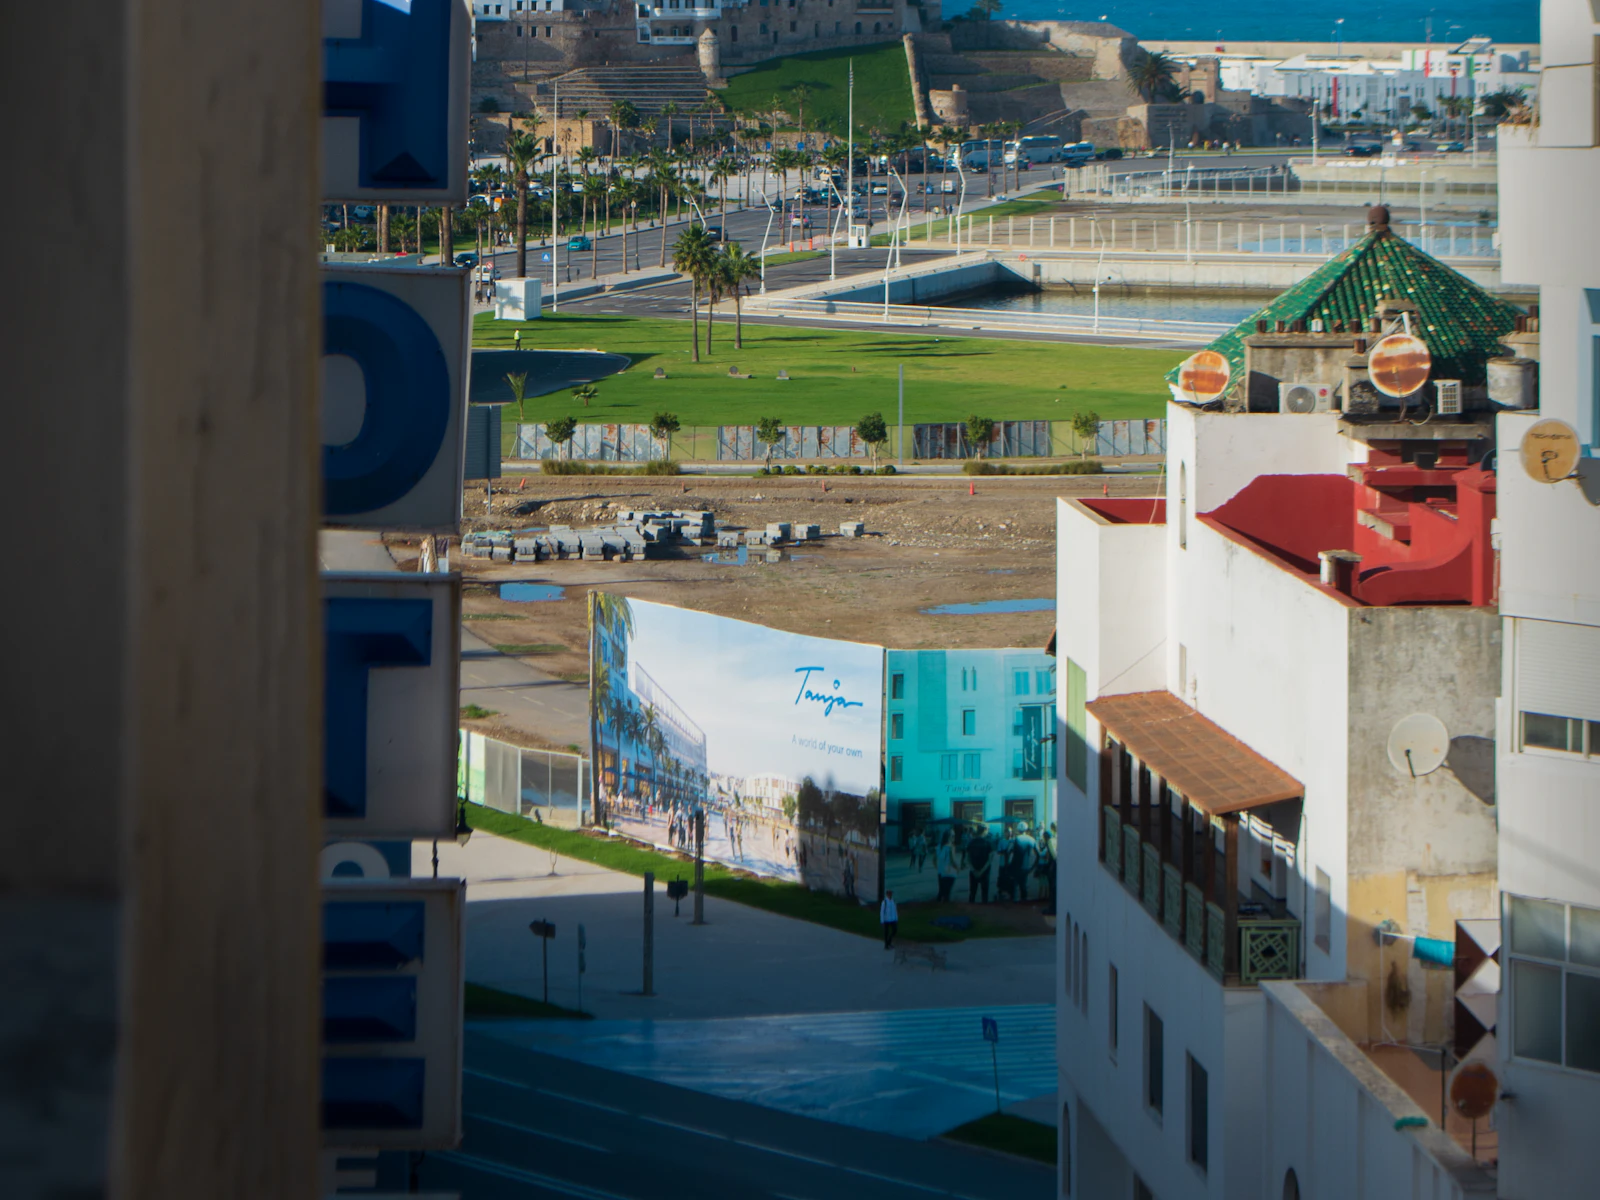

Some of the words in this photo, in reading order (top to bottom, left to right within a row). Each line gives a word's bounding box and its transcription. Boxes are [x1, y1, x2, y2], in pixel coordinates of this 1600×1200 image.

[795, 666, 863, 717] Tanja
[791, 734, 797, 744] A
[799, 737, 818, 749] world
[818, 740, 826, 751] of
[828, 743, 844, 754] your
[846, 747, 863, 758] own
